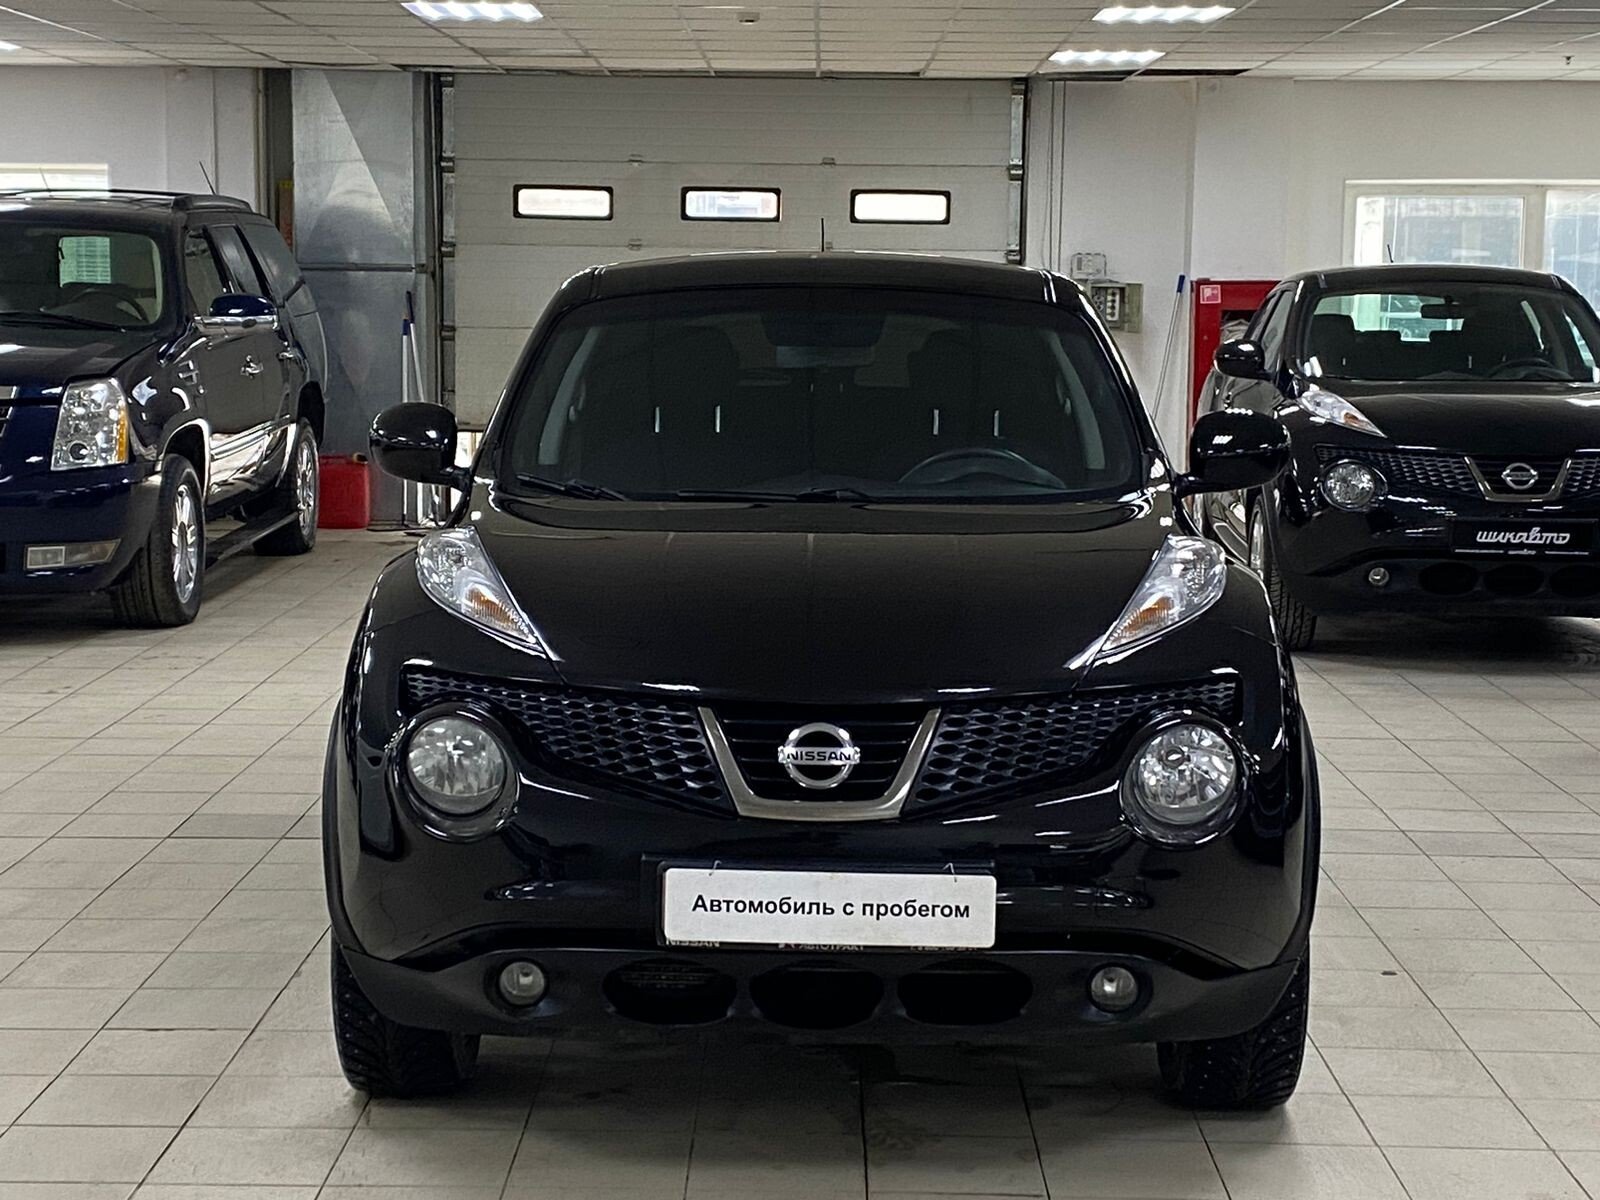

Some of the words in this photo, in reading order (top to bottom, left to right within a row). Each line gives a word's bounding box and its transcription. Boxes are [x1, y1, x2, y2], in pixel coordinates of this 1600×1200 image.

[1476, 527, 1570, 544] шикавто
[786, 751, 851, 761] NISSAN
[692, 894, 835, 915] Автомобиль
[842, 902, 854, 916] с
[862, 899, 970, 921] пробегом
